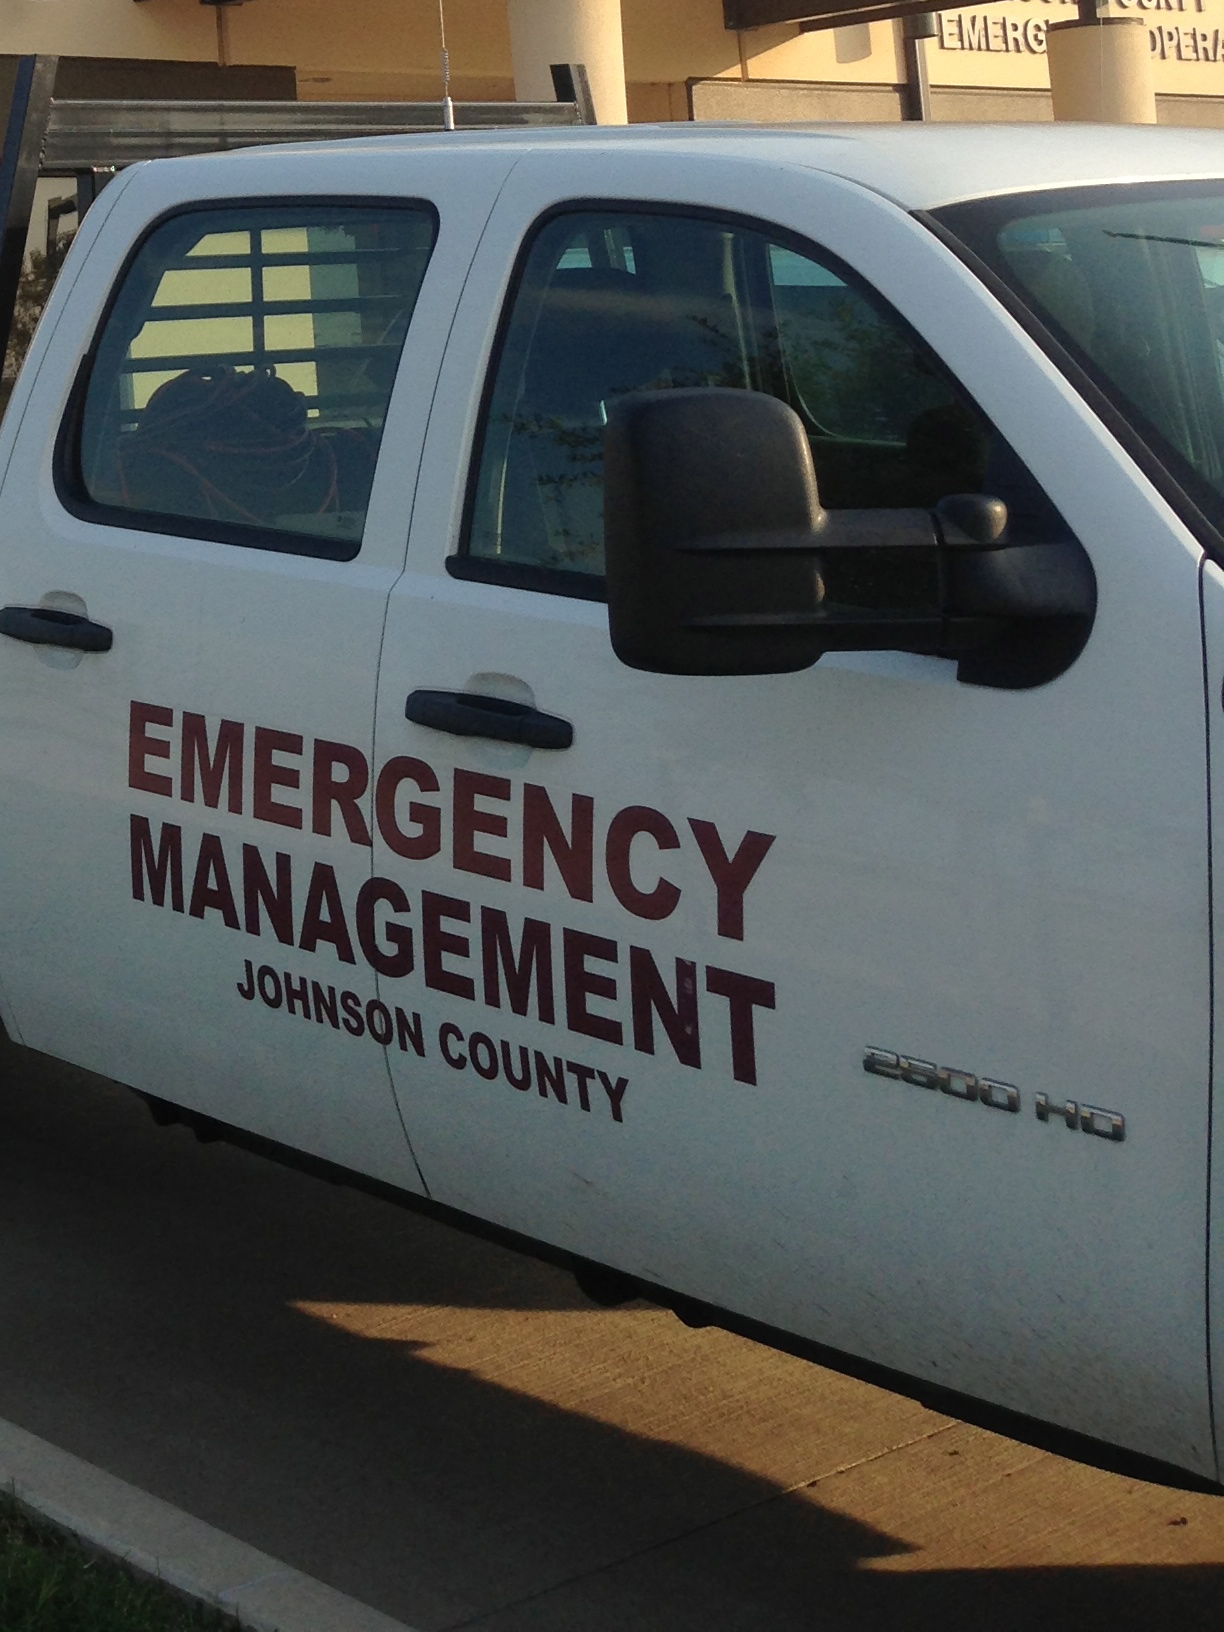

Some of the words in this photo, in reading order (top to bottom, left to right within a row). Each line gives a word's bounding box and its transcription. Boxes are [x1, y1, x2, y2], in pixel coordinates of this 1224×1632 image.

[937, 12, 1048, 55] EMERG
[128, 700, 776, 942] EMERGENCY
[129, 814, 776, 1087] MANAGEMENT
[237, 959, 426, 1058] JOHNSON
[438, 1022, 630, 1123] COUNTY
[863, 1045, 1021, 1113] 2500
[1035, 1091, 1126, 1142] HD
